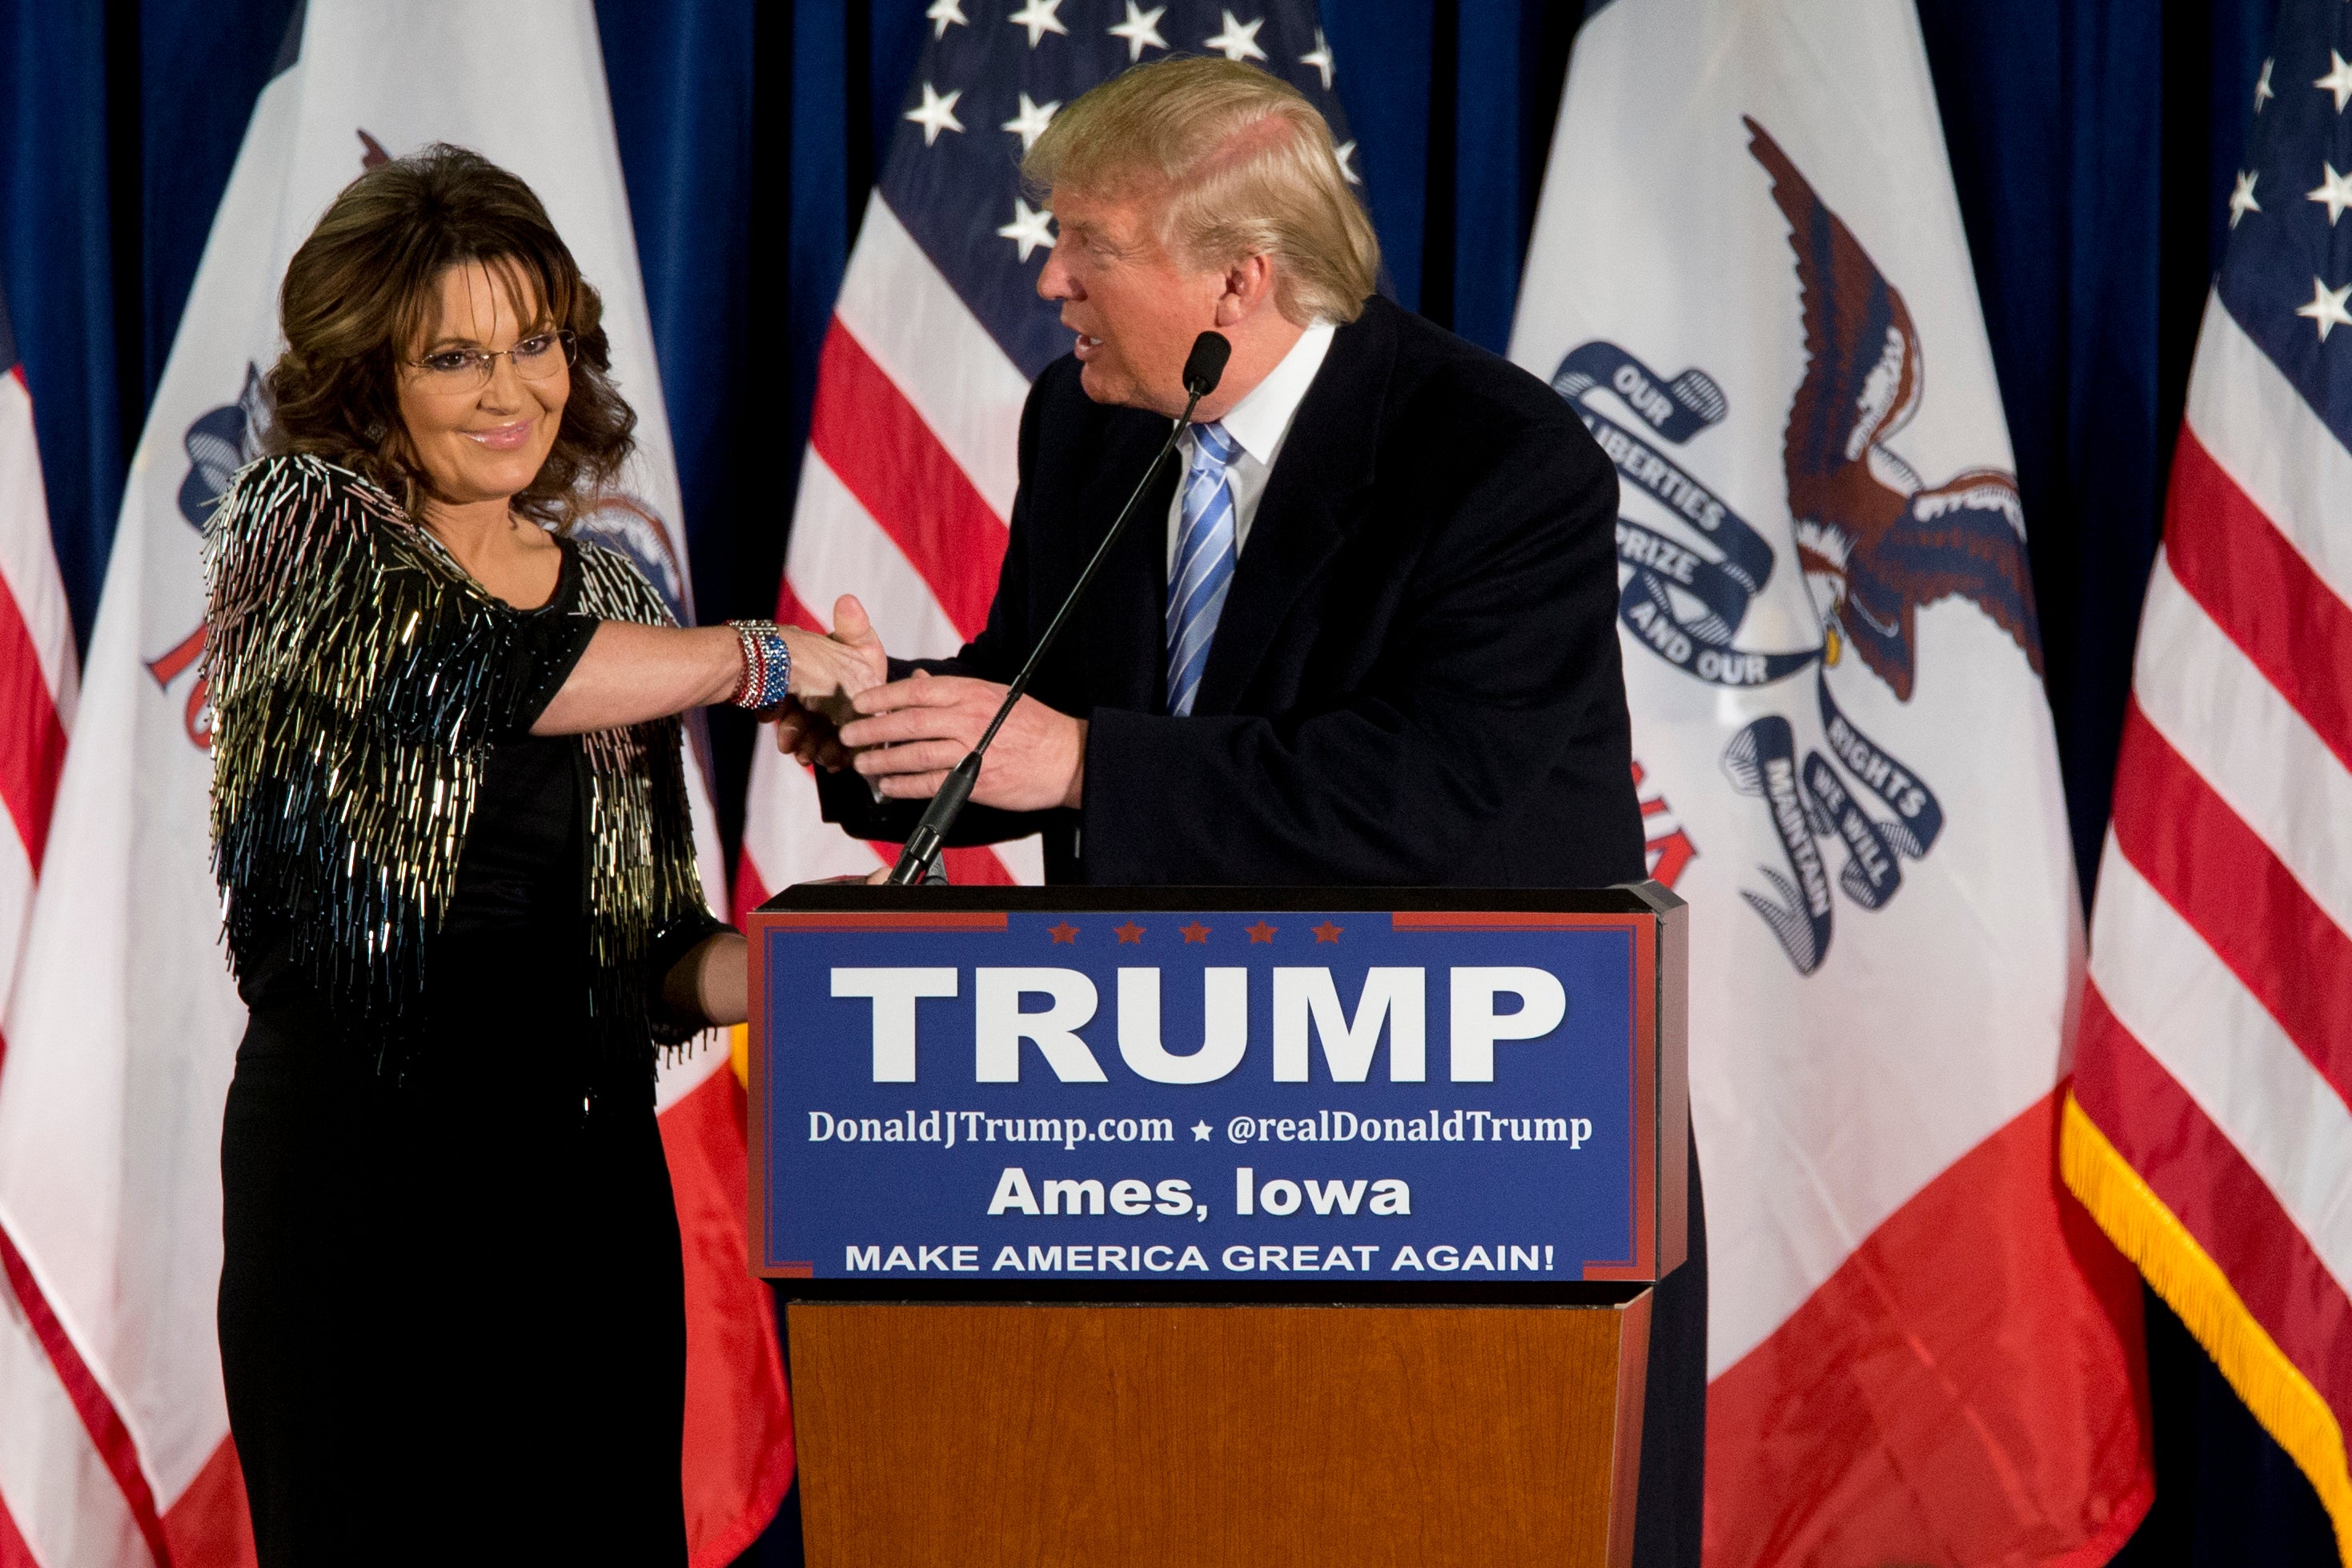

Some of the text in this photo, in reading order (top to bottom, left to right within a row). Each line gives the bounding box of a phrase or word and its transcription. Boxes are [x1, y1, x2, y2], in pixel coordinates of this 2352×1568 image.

[1613, 365, 1674, 427] OUR
[1583, 415, 1726, 531] IBERTIES
[1630, 601, 1768, 684] AND OUR
[1828, 716, 1928, 818] RIGHTS
[1764, 758, 1830, 918] MAINTAIN
[1812, 763, 1889, 887] WE WILL
[830, 966, 1567, 1085] TRUMP
[808, 1109, 1592, 1150] DonaldJTrump.com @realDonaldTrump
[986, 1167, 1411, 1223] Ames, Iowa
[845, 1245, 1554, 1272] MAKE AMERICA GREAT AGAIN!
